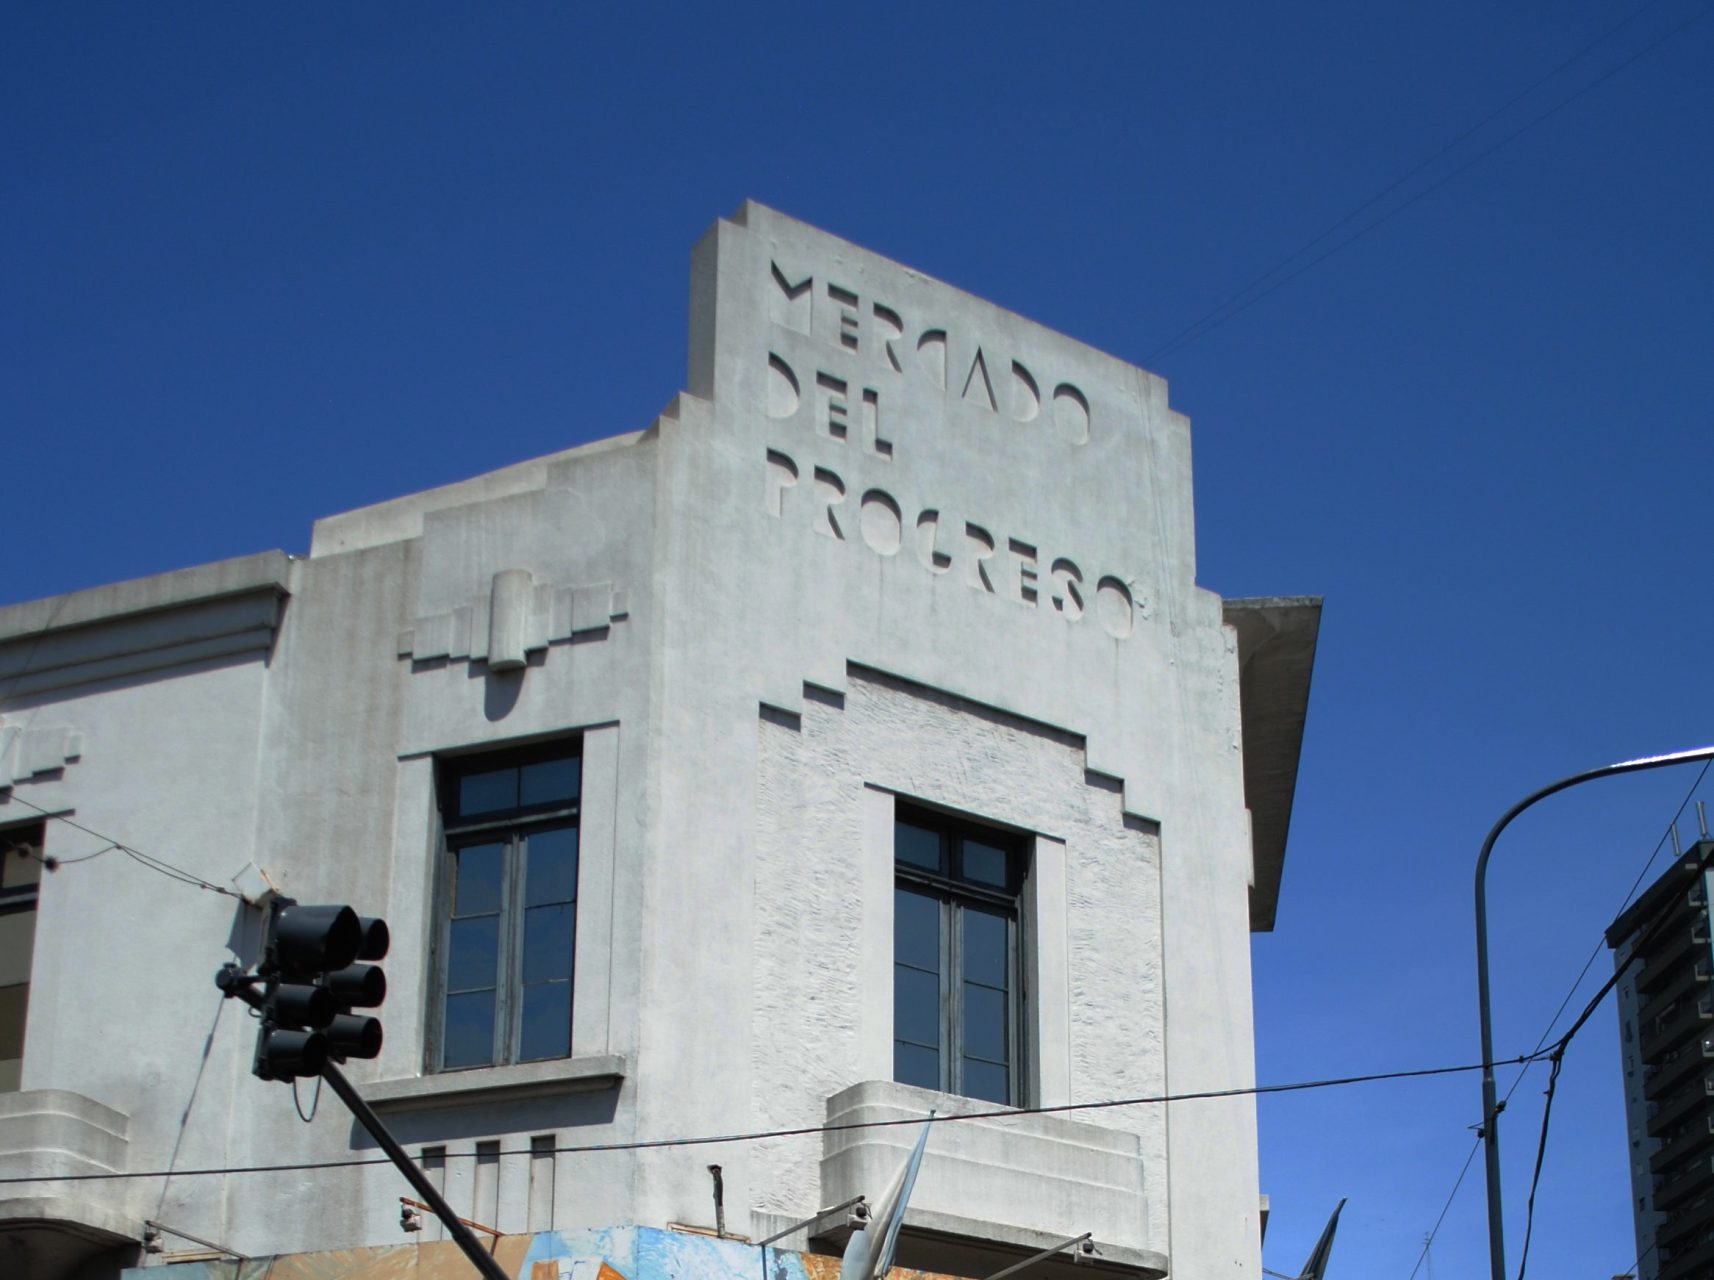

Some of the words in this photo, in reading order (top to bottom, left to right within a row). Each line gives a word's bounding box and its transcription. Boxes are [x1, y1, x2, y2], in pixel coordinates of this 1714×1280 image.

[766, 350, 894, 461] DEL
[769, 257, 1090, 446] MERCADO
[765, 446, 1134, 639] PROGRESO
